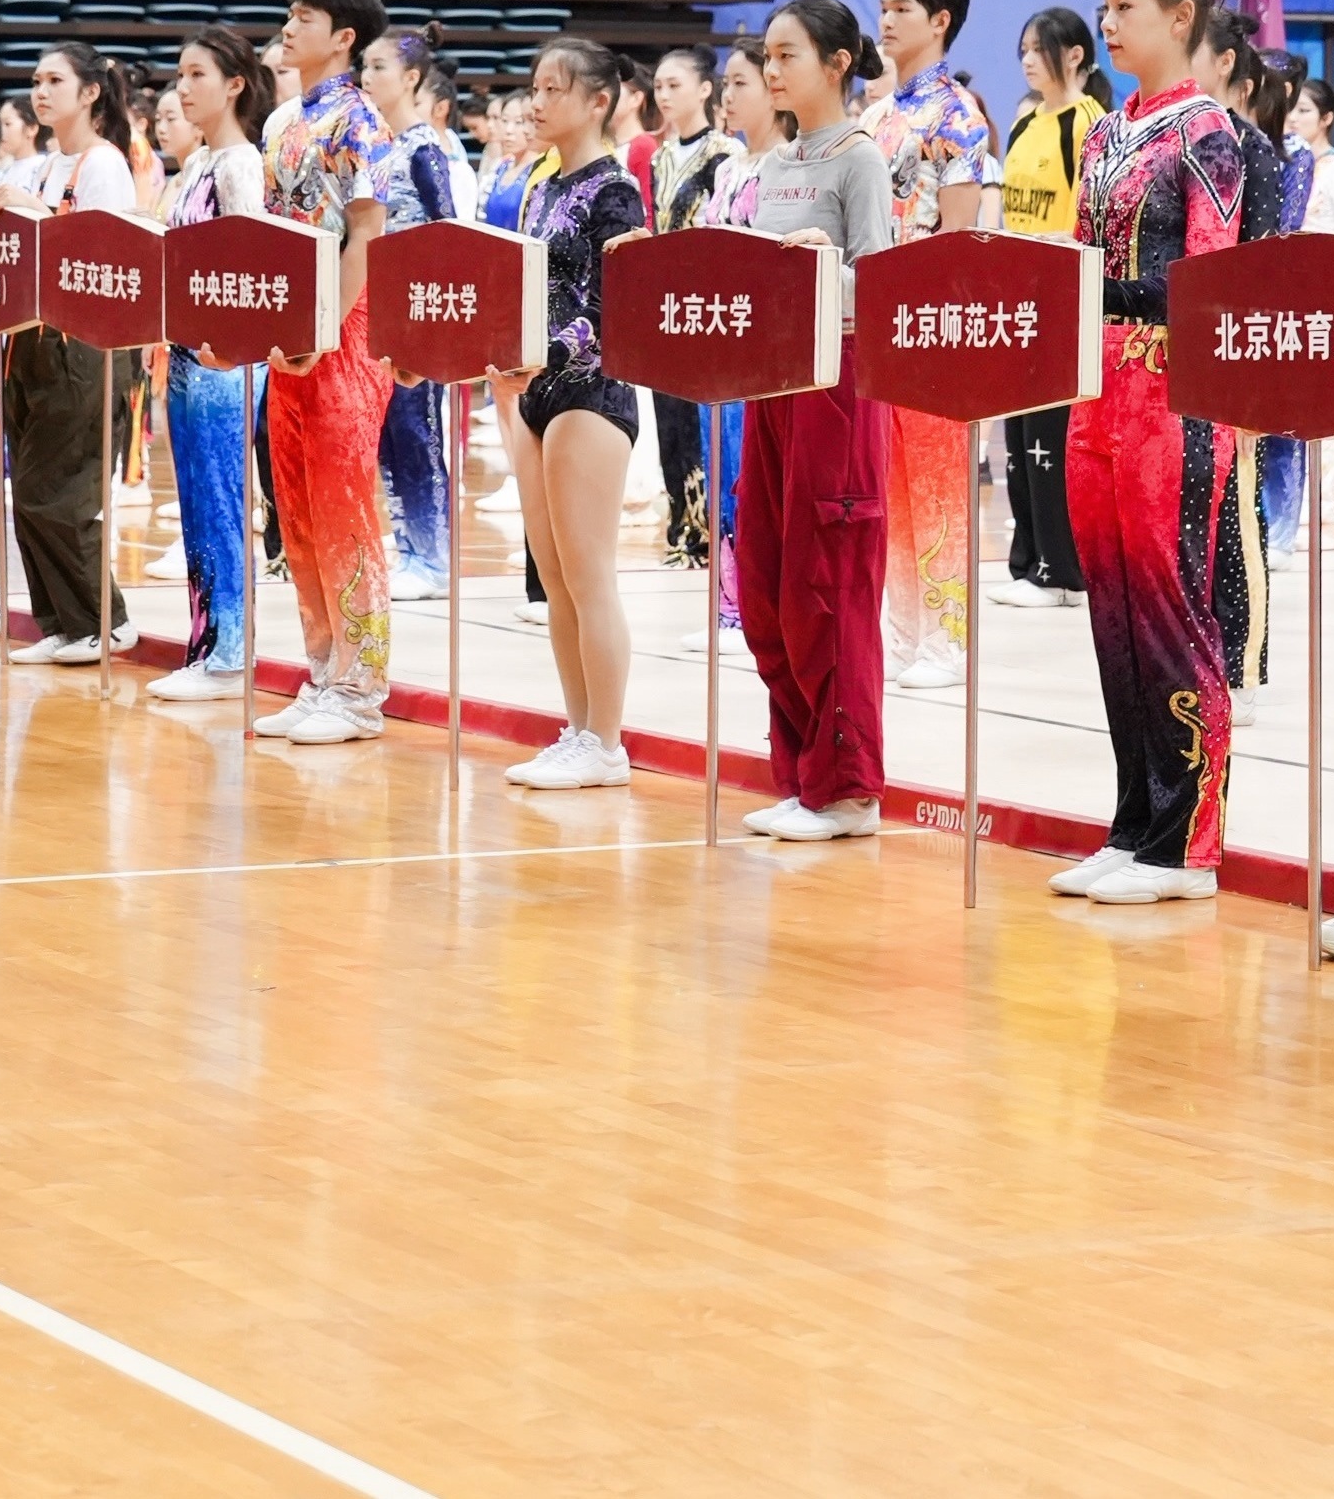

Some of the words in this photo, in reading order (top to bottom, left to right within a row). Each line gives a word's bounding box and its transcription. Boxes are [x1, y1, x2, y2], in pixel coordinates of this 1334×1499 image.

[58, 257, 142, 302] 北京交通大学
[189, 269, 289, 312] 中央民族大学
[408, 282, 478, 323] 清华大学
[659, 292, 753, 338] 北京大学
[891, 300, 1039, 350] 北京师范大学
